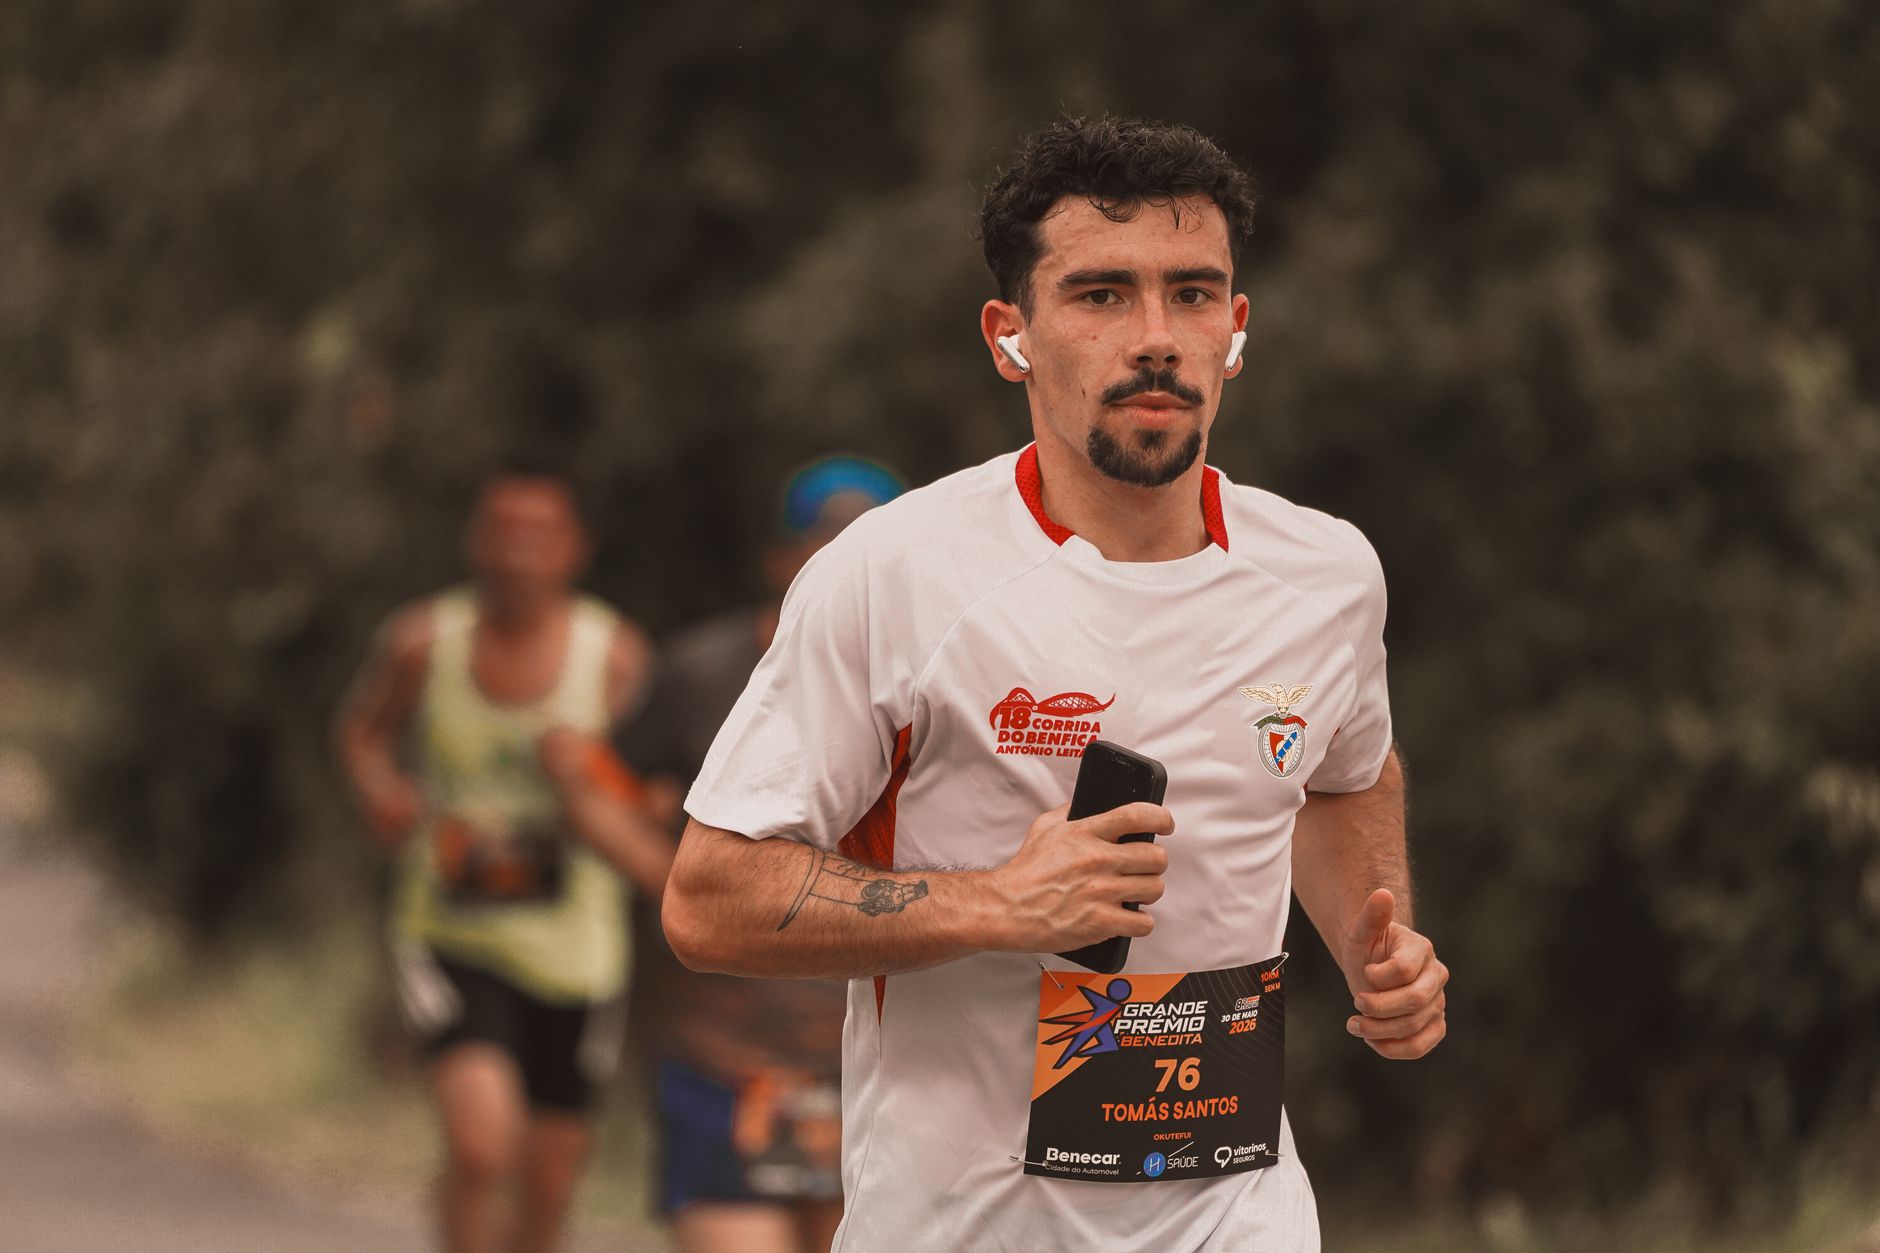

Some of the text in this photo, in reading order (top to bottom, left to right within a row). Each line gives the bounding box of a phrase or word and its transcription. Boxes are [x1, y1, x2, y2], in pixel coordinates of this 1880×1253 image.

[1032, 718, 1101, 733] CORRIDA
[997, 730, 1098, 747] DO BENFICA
[996, 744, 1053, 756] ANTÓNIO
[1123, 1000, 1208, 1017] GRANDE
[1242, 1009, 1258, 1018] MAIO
[1113, 1015, 1205, 1034] PRÉMIO
[1229, 1018, 1257, 1034] 2026
[1120, 1033, 1202, 1047] BENEDITA
[1154, 1057, 1200, 1092] 76
[1101, 1095, 1239, 1121] TOMÁS SANTOS
[1233, 1142, 1267, 1156] vitorinos
[1167, 1156, 1199, 1169] SAÚDE
[1082, 1167, 1120, 1176] Automóvel
